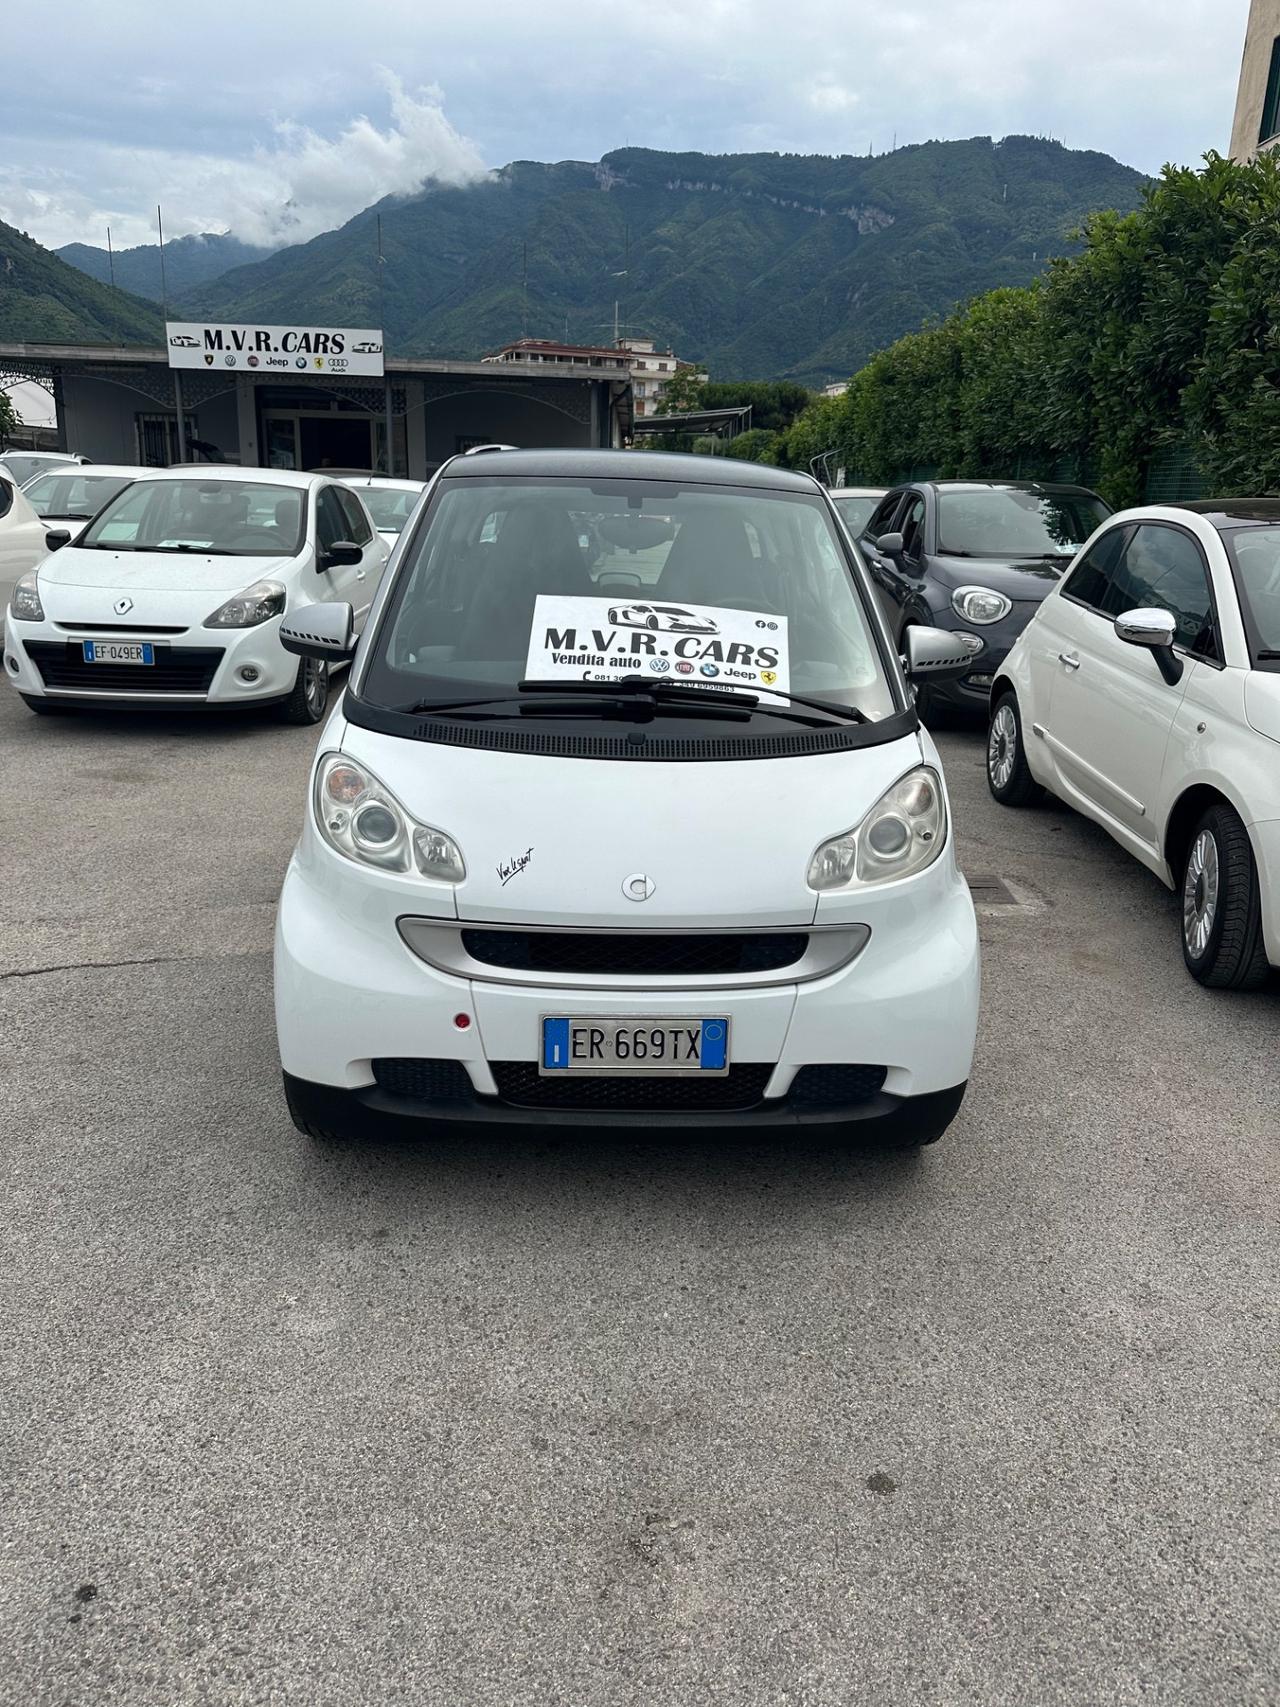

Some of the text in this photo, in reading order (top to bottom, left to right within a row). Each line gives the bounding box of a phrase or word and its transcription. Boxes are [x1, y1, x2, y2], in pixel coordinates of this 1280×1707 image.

[203, 329, 346, 354] M.V.R.CARS
[266, 357, 289, 367] Jeep
[544, 627, 779, 668] M.V.R.CARS
[551, 652, 642, 669] Vendita auto
[724, 667, 757, 680] Jeep
